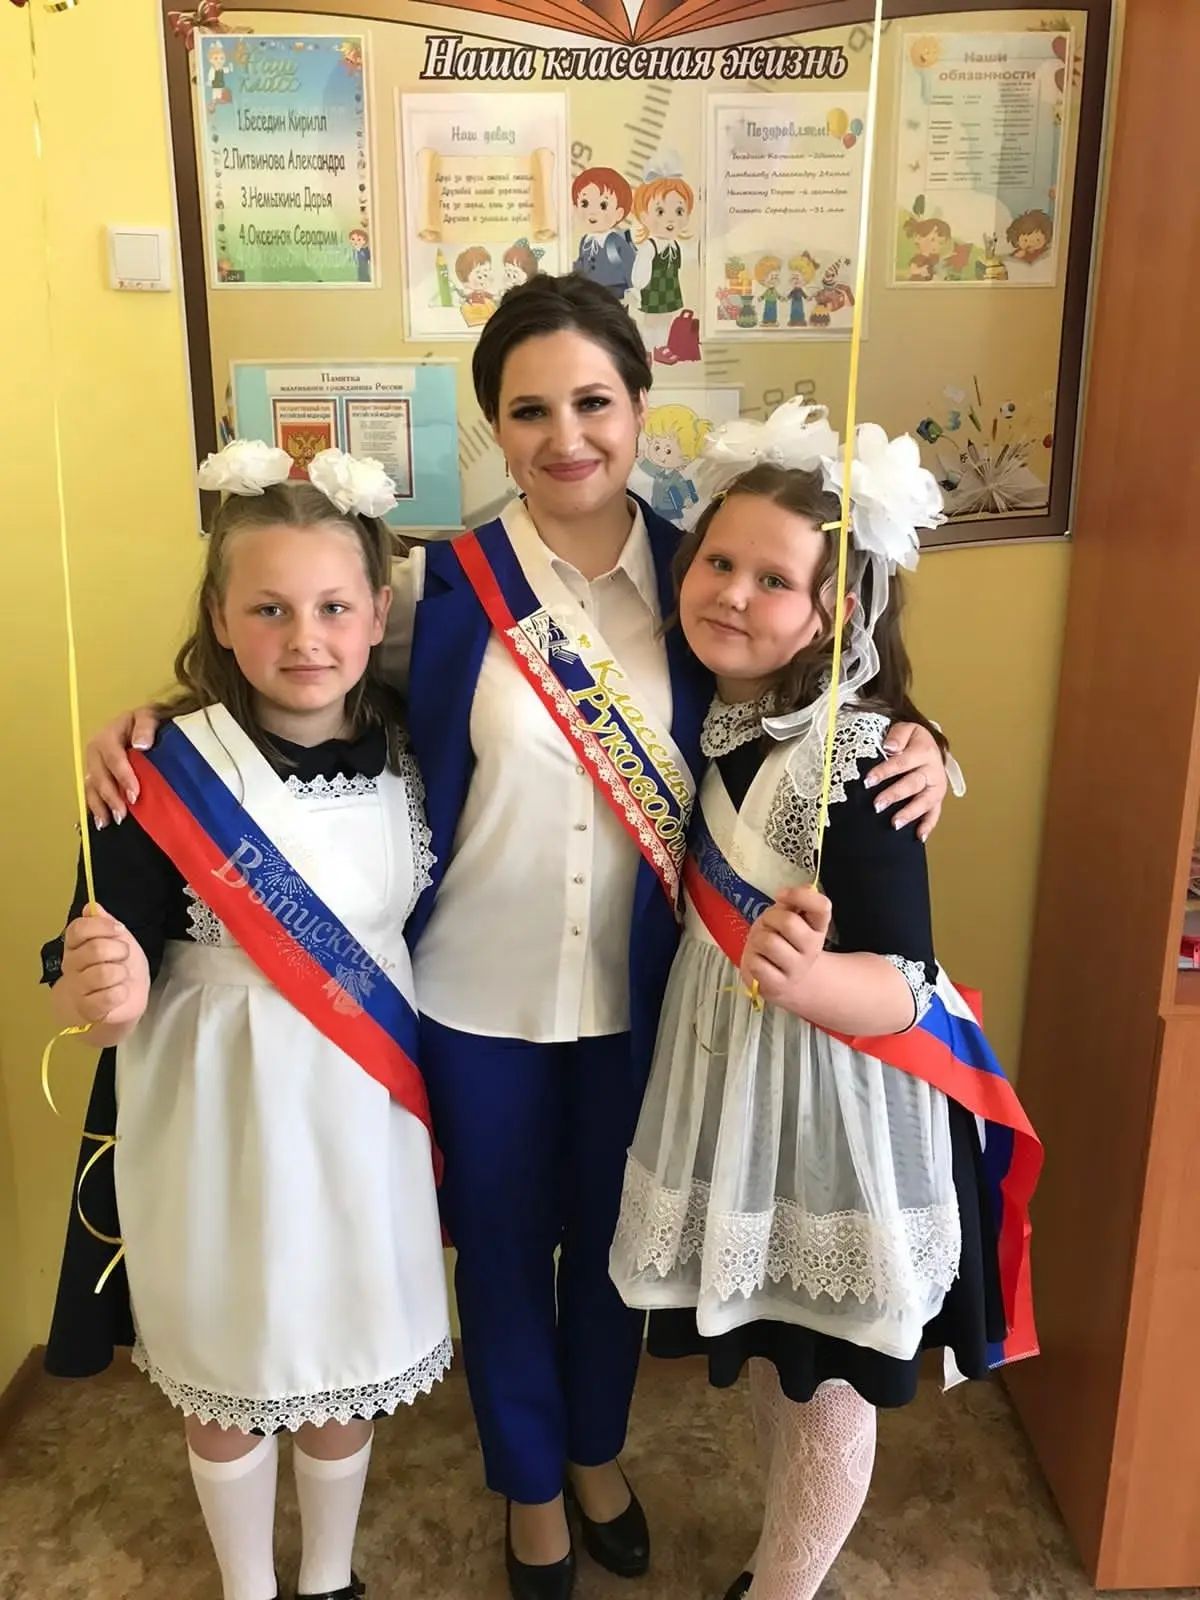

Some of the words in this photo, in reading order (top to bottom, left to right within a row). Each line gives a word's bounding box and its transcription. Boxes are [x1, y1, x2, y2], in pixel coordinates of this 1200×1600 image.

[419, 36, 535, 80] Наша
[542, 45, 714, 80] классная
[721, 46, 848, 80] жизнь
[964, 51, 1008, 64] Наши
[939, 68, 1036, 81] обязанности
[288, 110, 327, 137] Кирилл
[747, 122, 830, 141] Поздравляем!
[451, 126, 477, 142] Наш
[223, 148, 285, 171] 2.Литвинова
[287, 149, 345, 176] Александра
[241, 186, 301, 210] 3.Немыкина
[303, 187, 332, 215] Дарья
[239, 224, 292, 246] 4.Оксенюк
[320, 373, 360, 382] Памятка
